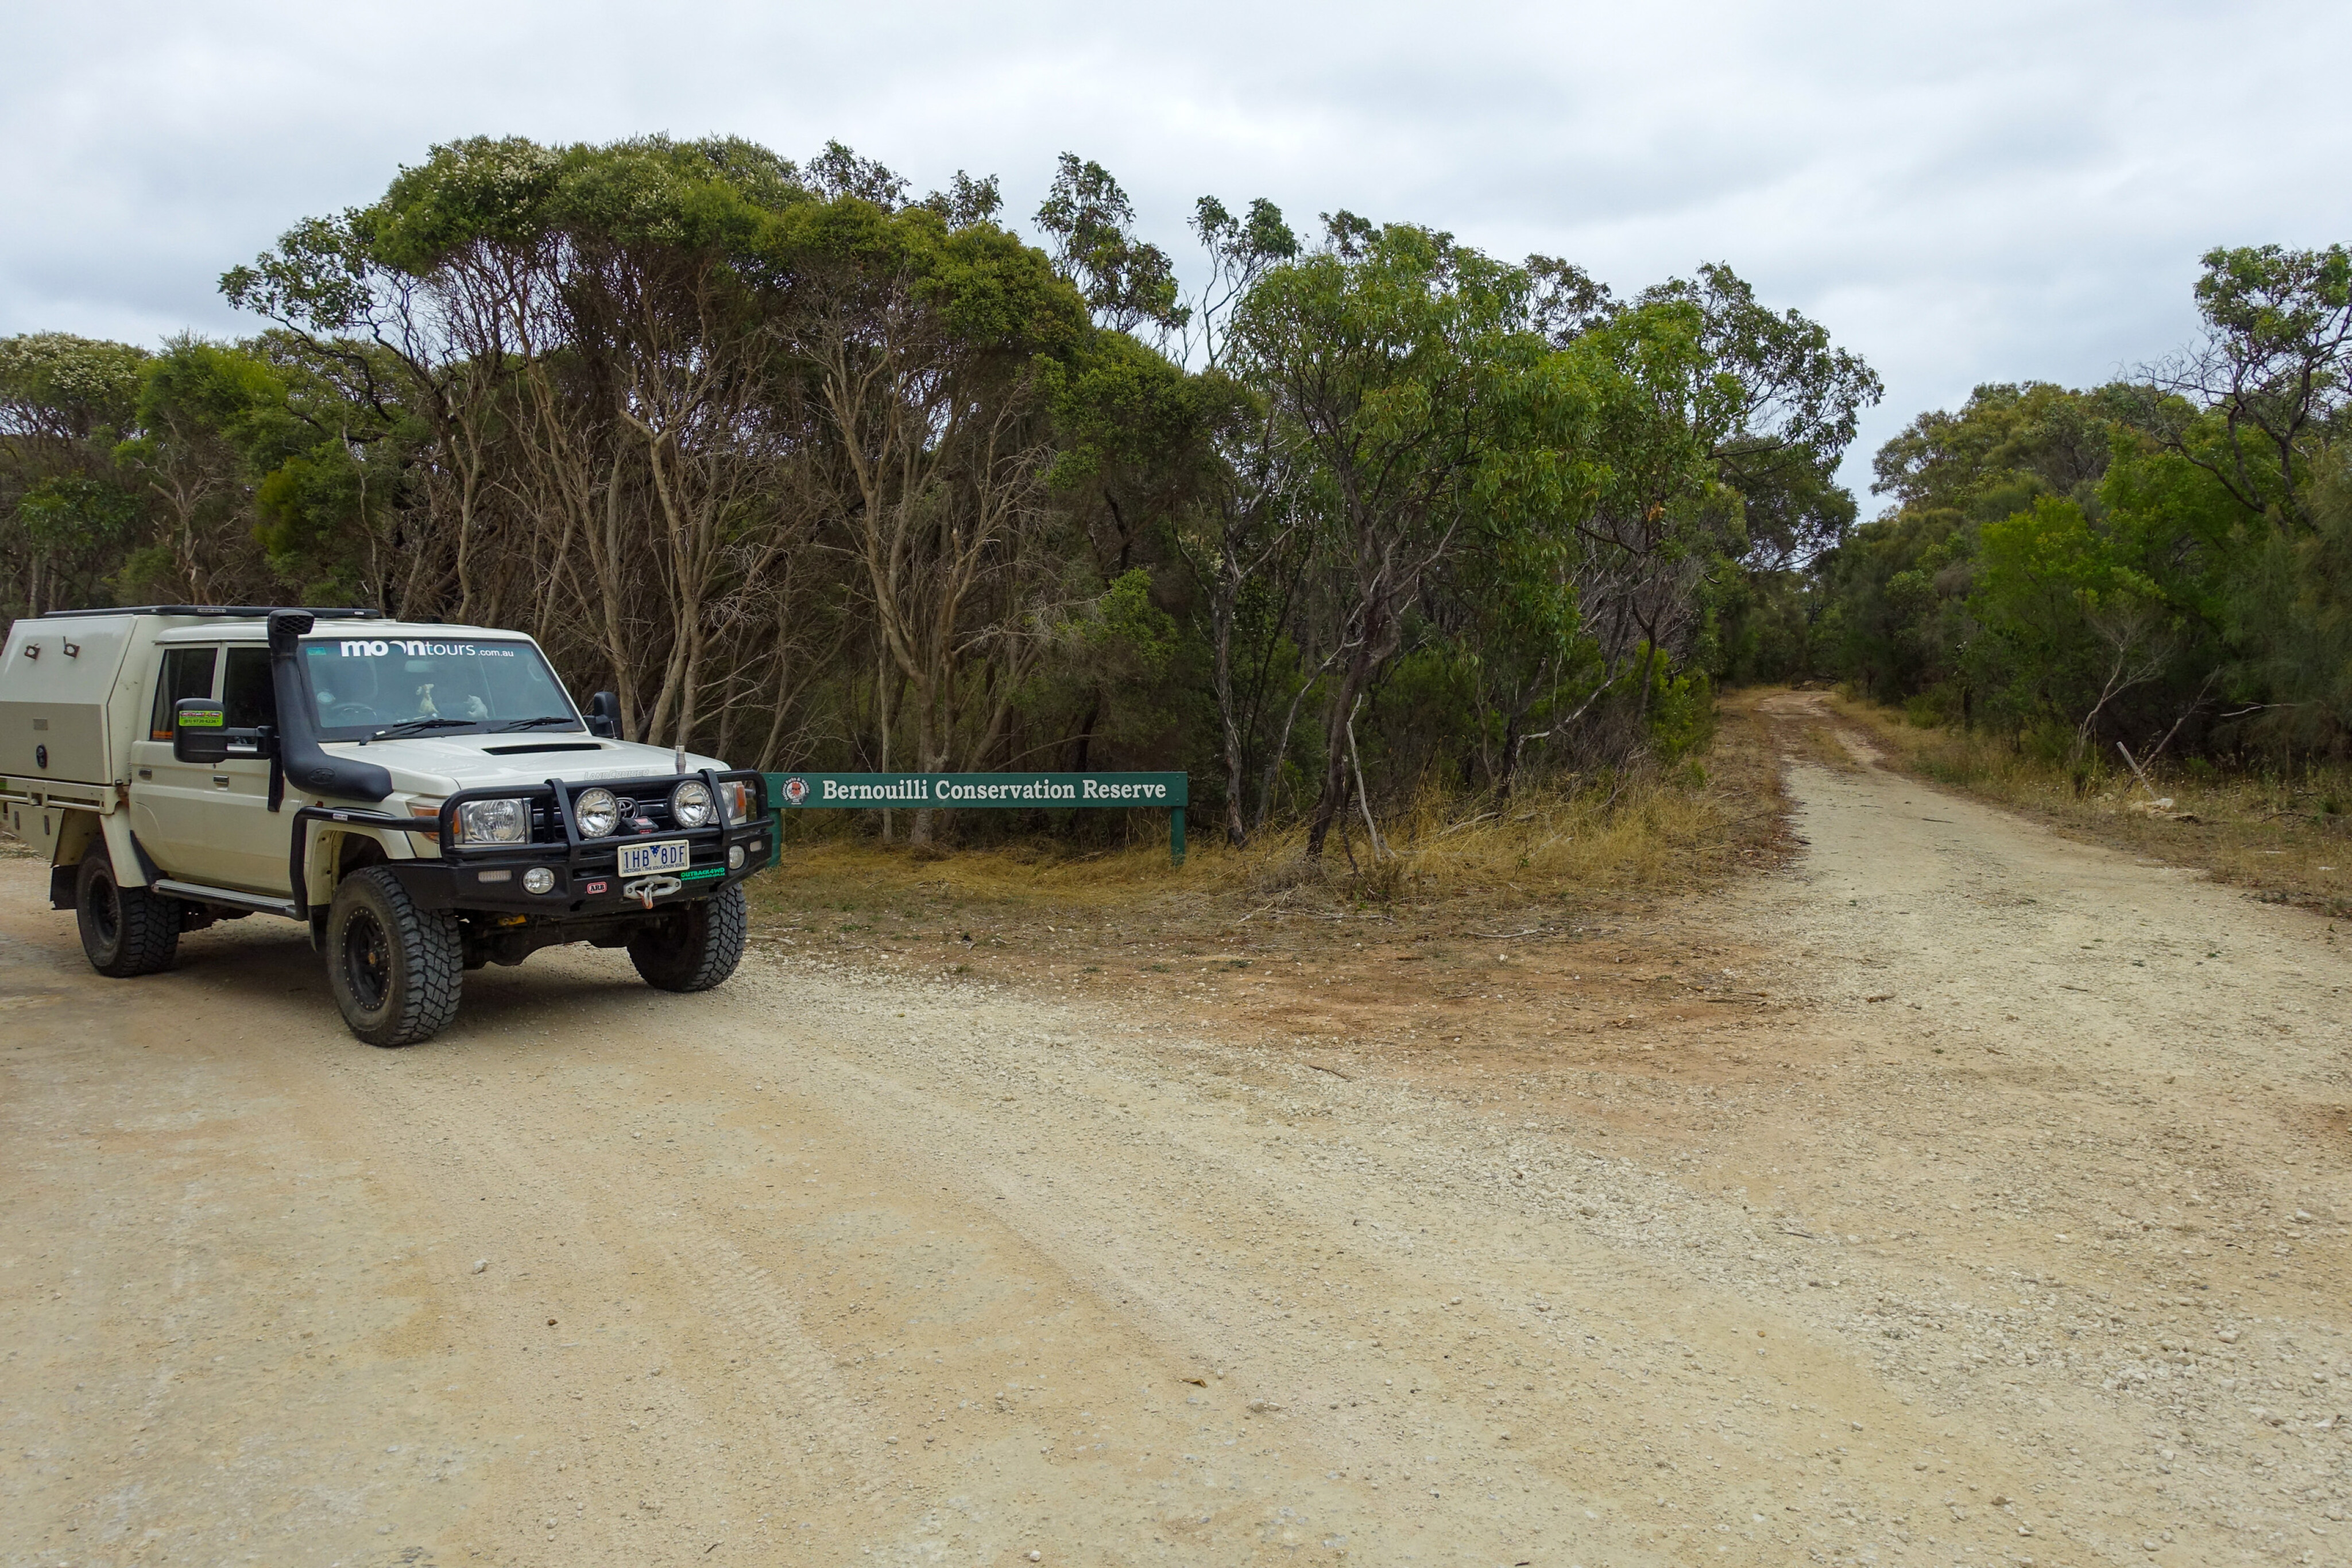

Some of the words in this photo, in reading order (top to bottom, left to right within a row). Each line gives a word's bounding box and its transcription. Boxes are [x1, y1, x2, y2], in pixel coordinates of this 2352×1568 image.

[822, 779, 928, 800] Bernouilli
[935, 779, 1076, 800] Conservation
[1082, 779, 1166, 799] Reserve
[624, 849, 649, 869] 1HB
[662, 846, 685, 865] 8DF
